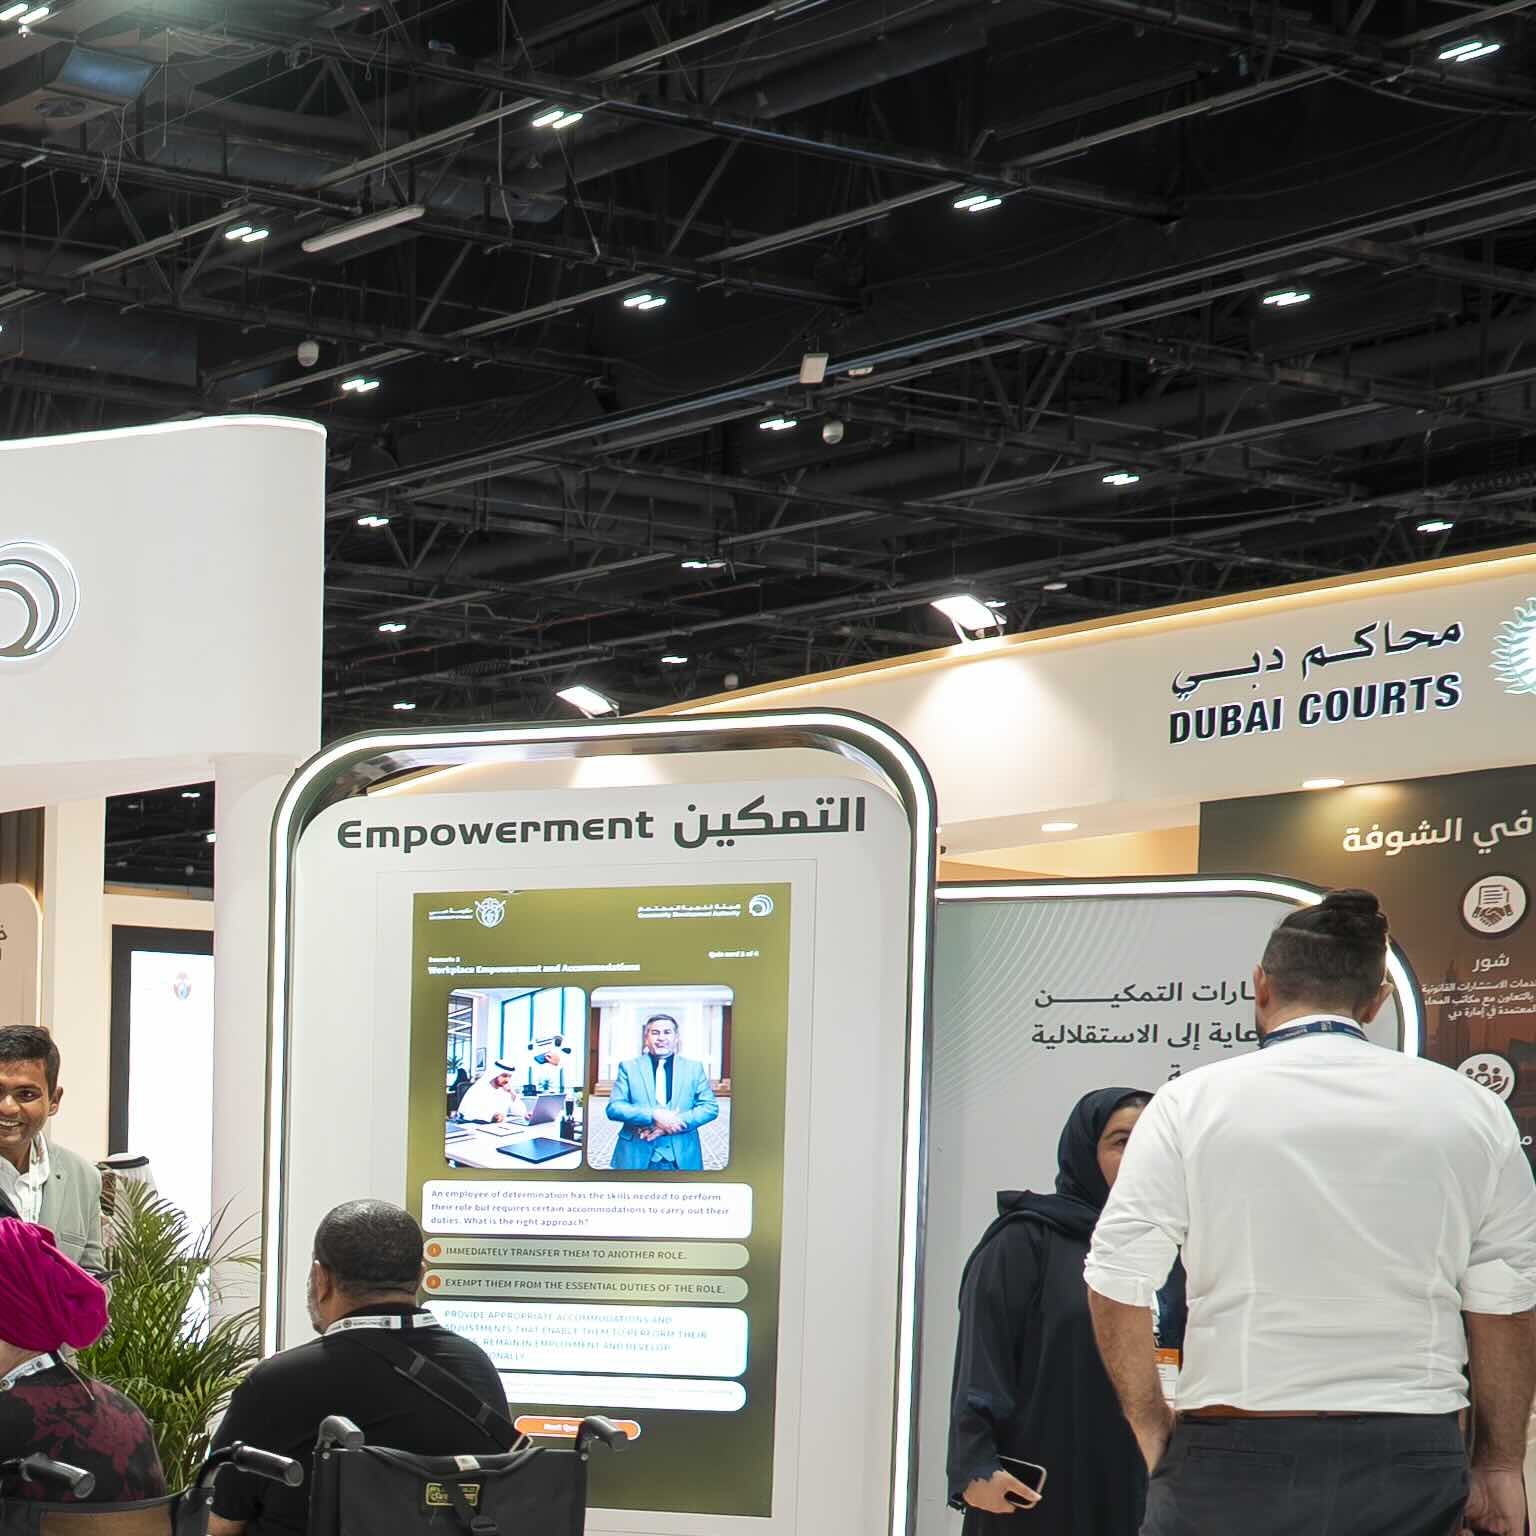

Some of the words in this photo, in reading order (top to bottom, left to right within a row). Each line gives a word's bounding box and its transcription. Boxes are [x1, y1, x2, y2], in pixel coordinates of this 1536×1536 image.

[1302, 620, 1463, 680] محاكم
[1171, 645, 1285, 698] دبي
[1169, 697, 1284, 744] DUBAI
[1298, 672, 1463, 729] COURTS
[337, 809, 655, 854] Empowerment
[673, 795, 866, 848] التمكين
[1473, 809, 1533, 854] في
[1343, 817, 1463, 856] الشوفة
[1472, 951, 1511, 972] شور
[1034, 981, 1183, 1008] التمكين
[1192, 980, 1255, 1005] ارات
[1031, 1023, 1158, 1050] الاستقلالية
[1167, 1022, 1200, 1050] إلى
[431, 1190, 443, 1198] An
[445, 1190, 489, 1200] employee
[502, 1191, 569, 1199] determination
[589, 1192, 604, 1200] the
[607, 1192, 631, 1200] skills
[633, 1193, 668, 1201] needed
[670, 1193, 680, 1201] to
[682, 1193, 722, 1203] perform
[431, 1203, 453, 1211] their
[474, 1204, 490, 1212] but
[492, 1205, 530, 1213] requires
[532, 1205, 564, 1213] certain
[566, 1206, 646, 1214] accommodations
[660, 1208, 685, 1216] carry
[706, 1207, 729, 1215] their
[516, 1218, 538, 1227] right
[446, 1247, 508, 1256] IMMEDIATELY
[511, 1249, 560, 1257] TRANSFER
[562, 1249, 590, 1257] THEM
[592, 1250, 605, 1258] TO
[607, 1250, 655, 1259] ANOTHER
[444, 1278, 483, 1288] EXEMPT
[485, 1279, 512, 1288] THEM
[514, 1280, 542, 1289] FROM
[544, 1281, 563, 1290] THE
[565, 1281, 617, 1291] ESSENTIAL
[619, 1283, 656, 1292] DUTIES
[658, 1284, 672, 1292] OF
[674, 1285, 694, 1293] THE
